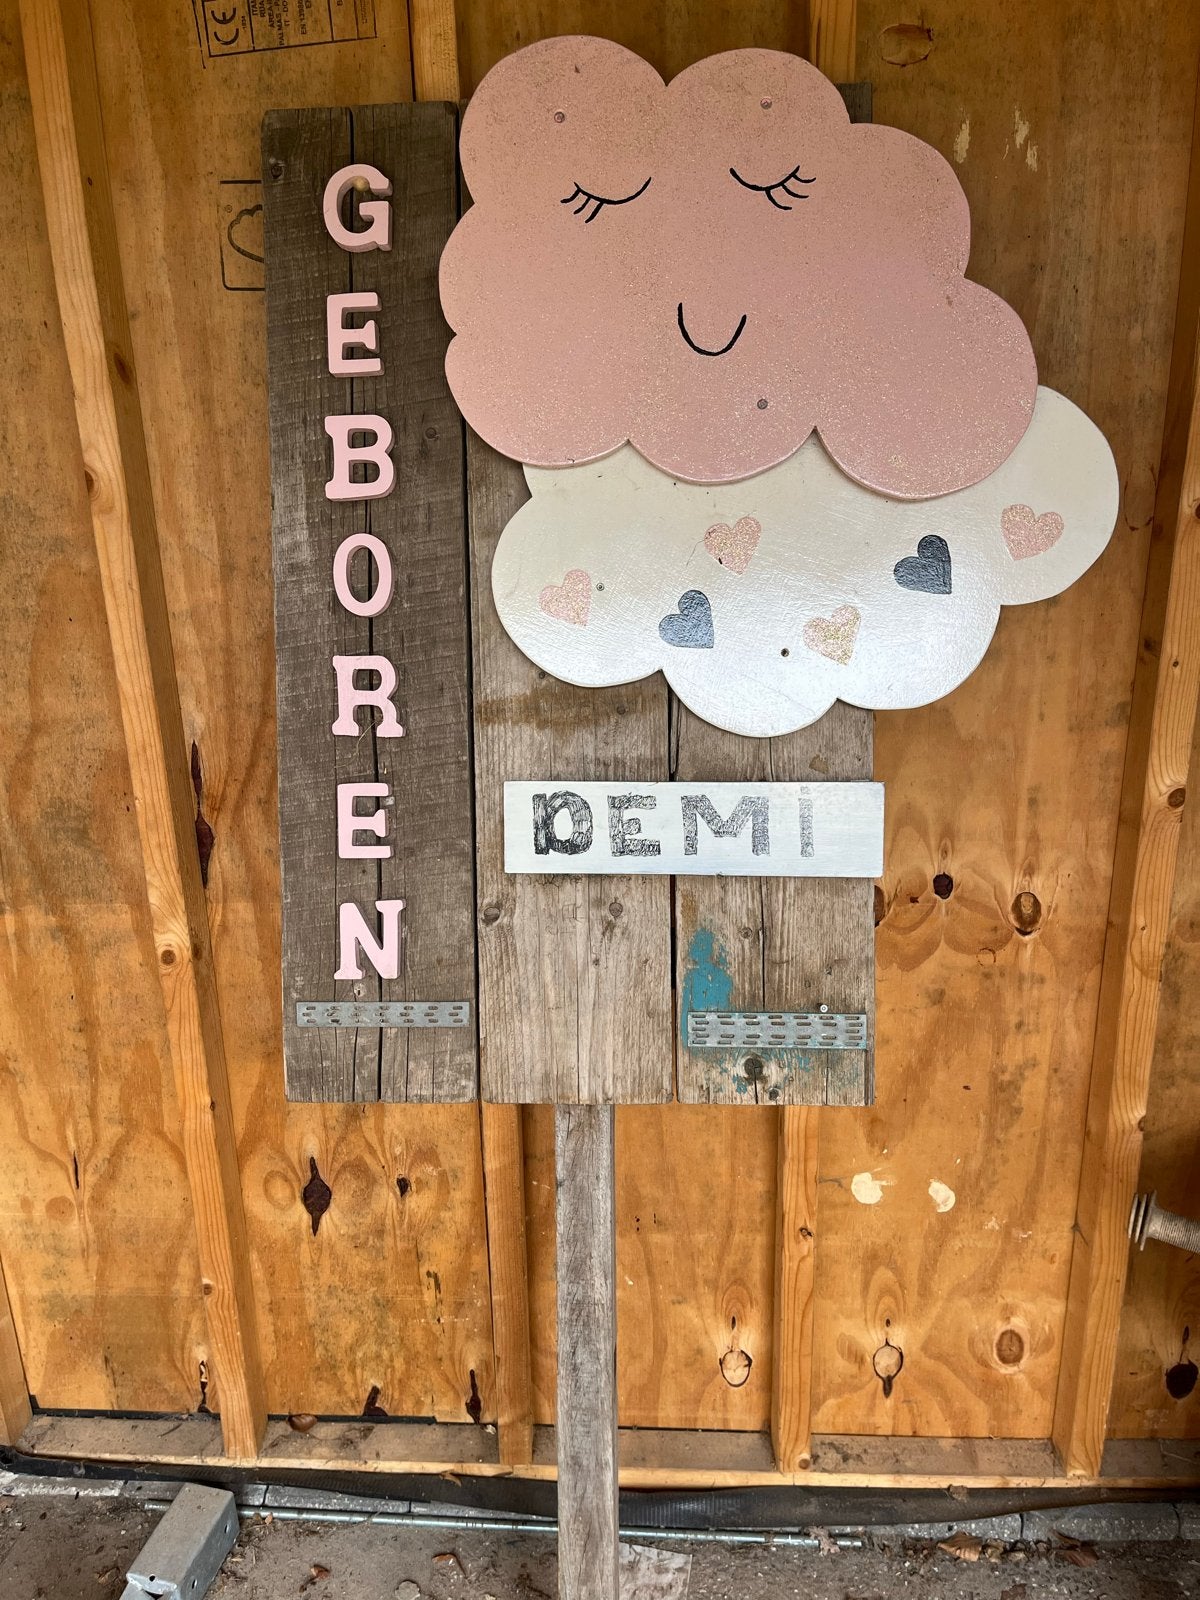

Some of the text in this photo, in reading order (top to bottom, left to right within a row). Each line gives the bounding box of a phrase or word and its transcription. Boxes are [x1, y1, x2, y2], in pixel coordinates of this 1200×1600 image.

[211, 8, 239, 46] CE
[300, 24, 307, 35] EN
[322, 164, 406, 980] GEBOREN
